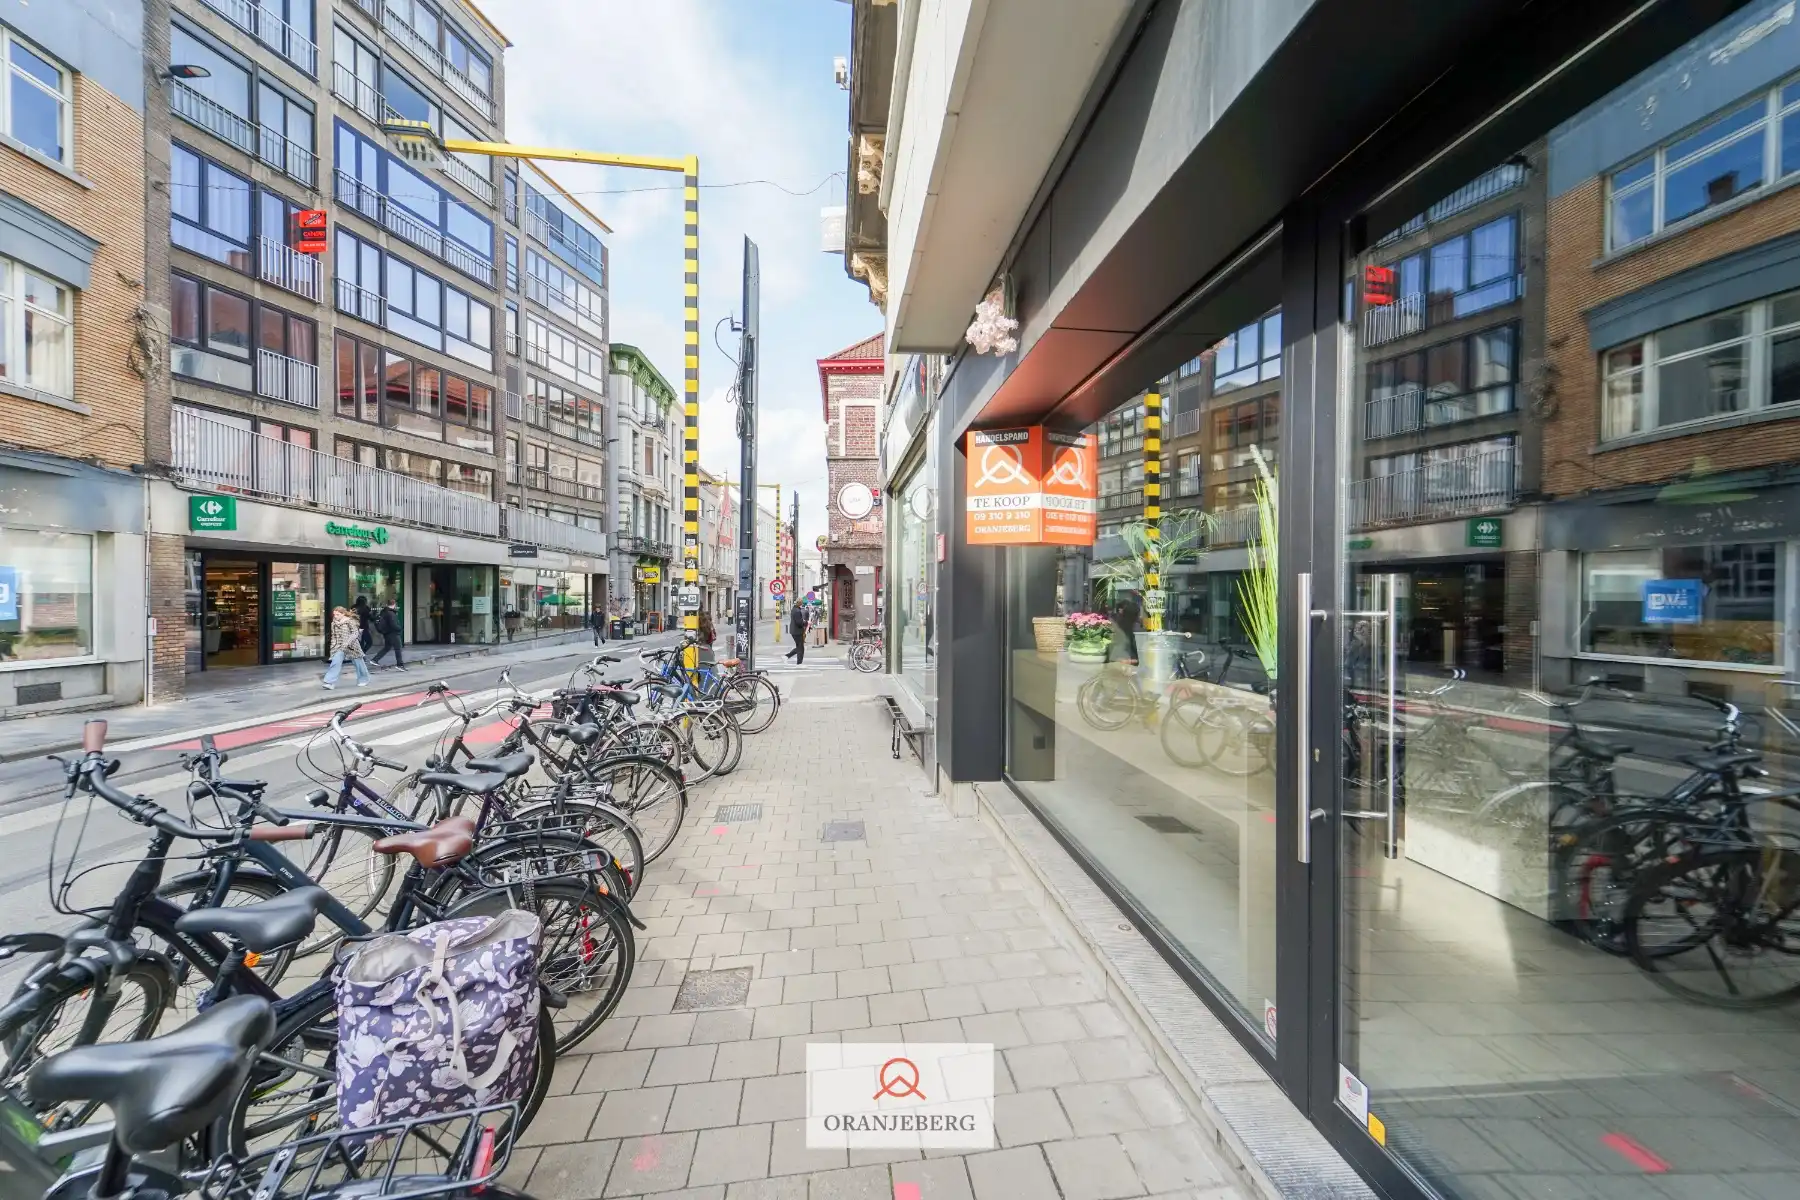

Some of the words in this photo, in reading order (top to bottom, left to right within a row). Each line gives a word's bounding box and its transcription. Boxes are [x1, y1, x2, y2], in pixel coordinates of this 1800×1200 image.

[975, 431, 1029, 444] HANDELSPAND
[974, 498, 990, 508] TE
[994, 496, 1031, 507] KOOP
[988, 512, 1003, 521] 310
[1014, 511, 1031, 520] 310
[325, 521, 370, 539] Carrefour
[974, 524, 1031, 534] ORANJEBERG
[375, 798, 408, 822] BRIGHTON
[175, 931, 220, 967] BATAVUS
